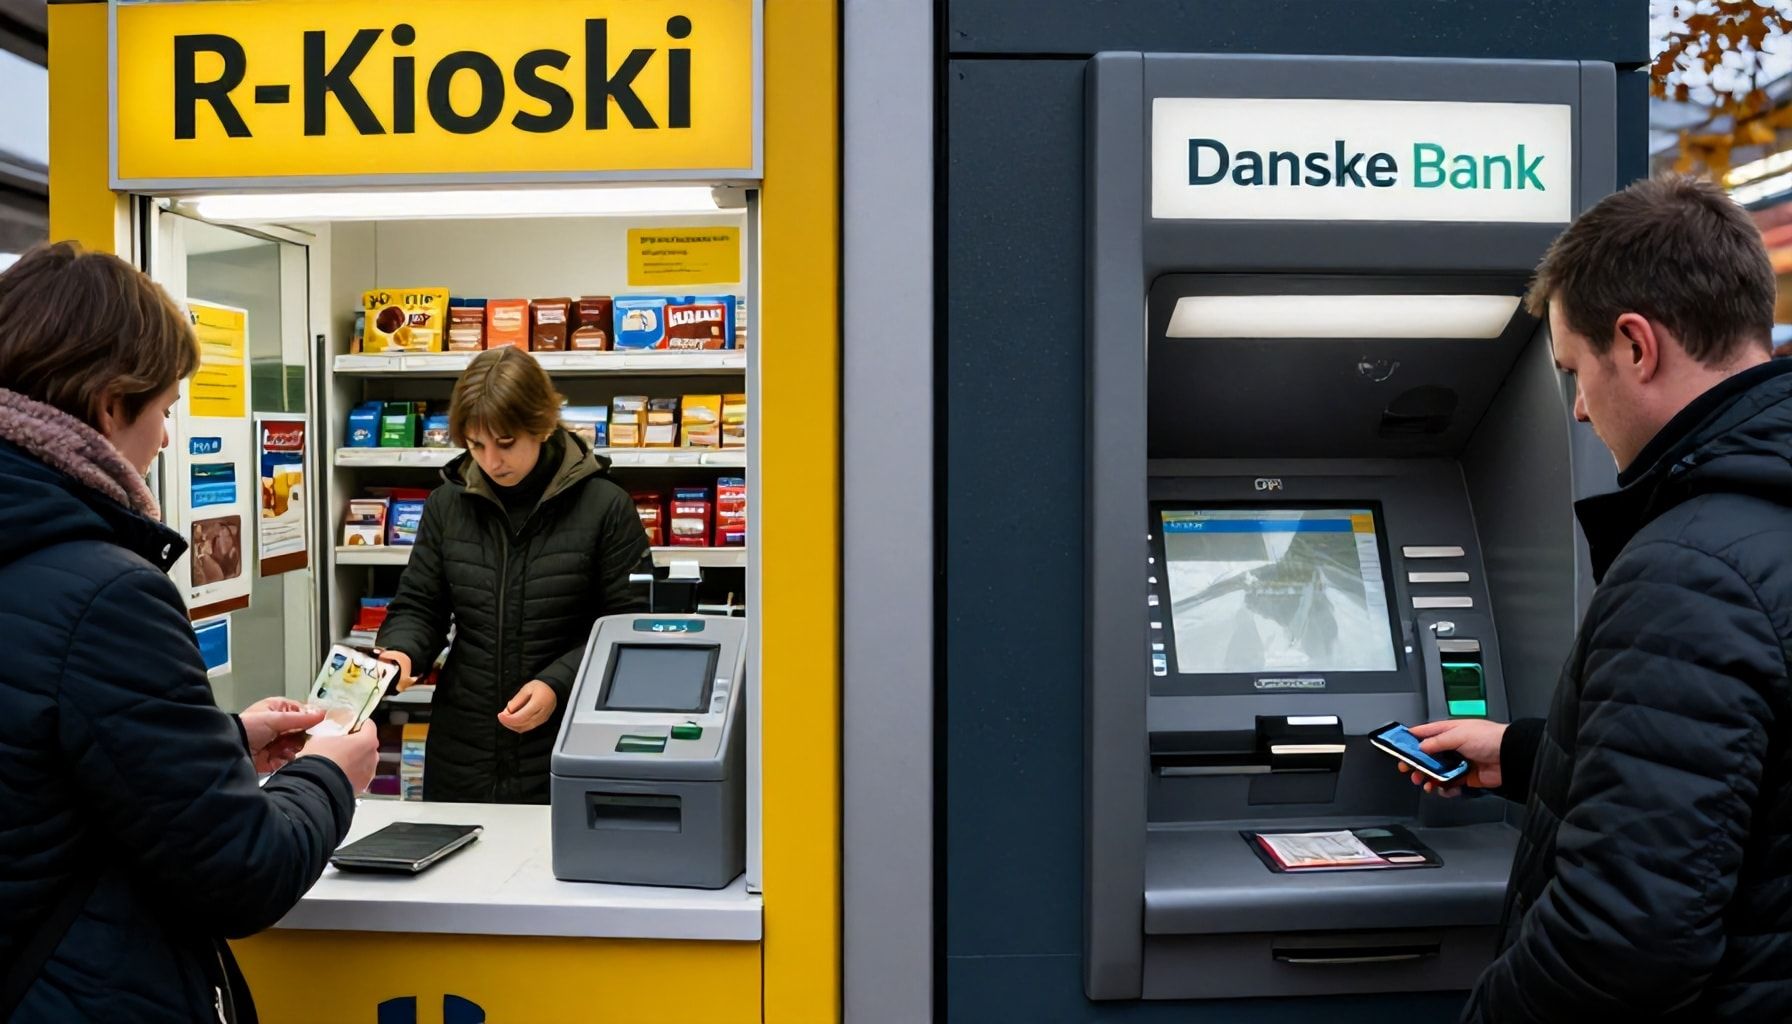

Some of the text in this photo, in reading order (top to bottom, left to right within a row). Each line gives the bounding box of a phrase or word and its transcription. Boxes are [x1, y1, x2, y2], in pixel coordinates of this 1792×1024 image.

[173, 15, 693, 140] R-Kioski
[1187, 138, 1546, 192] Danske Bank
